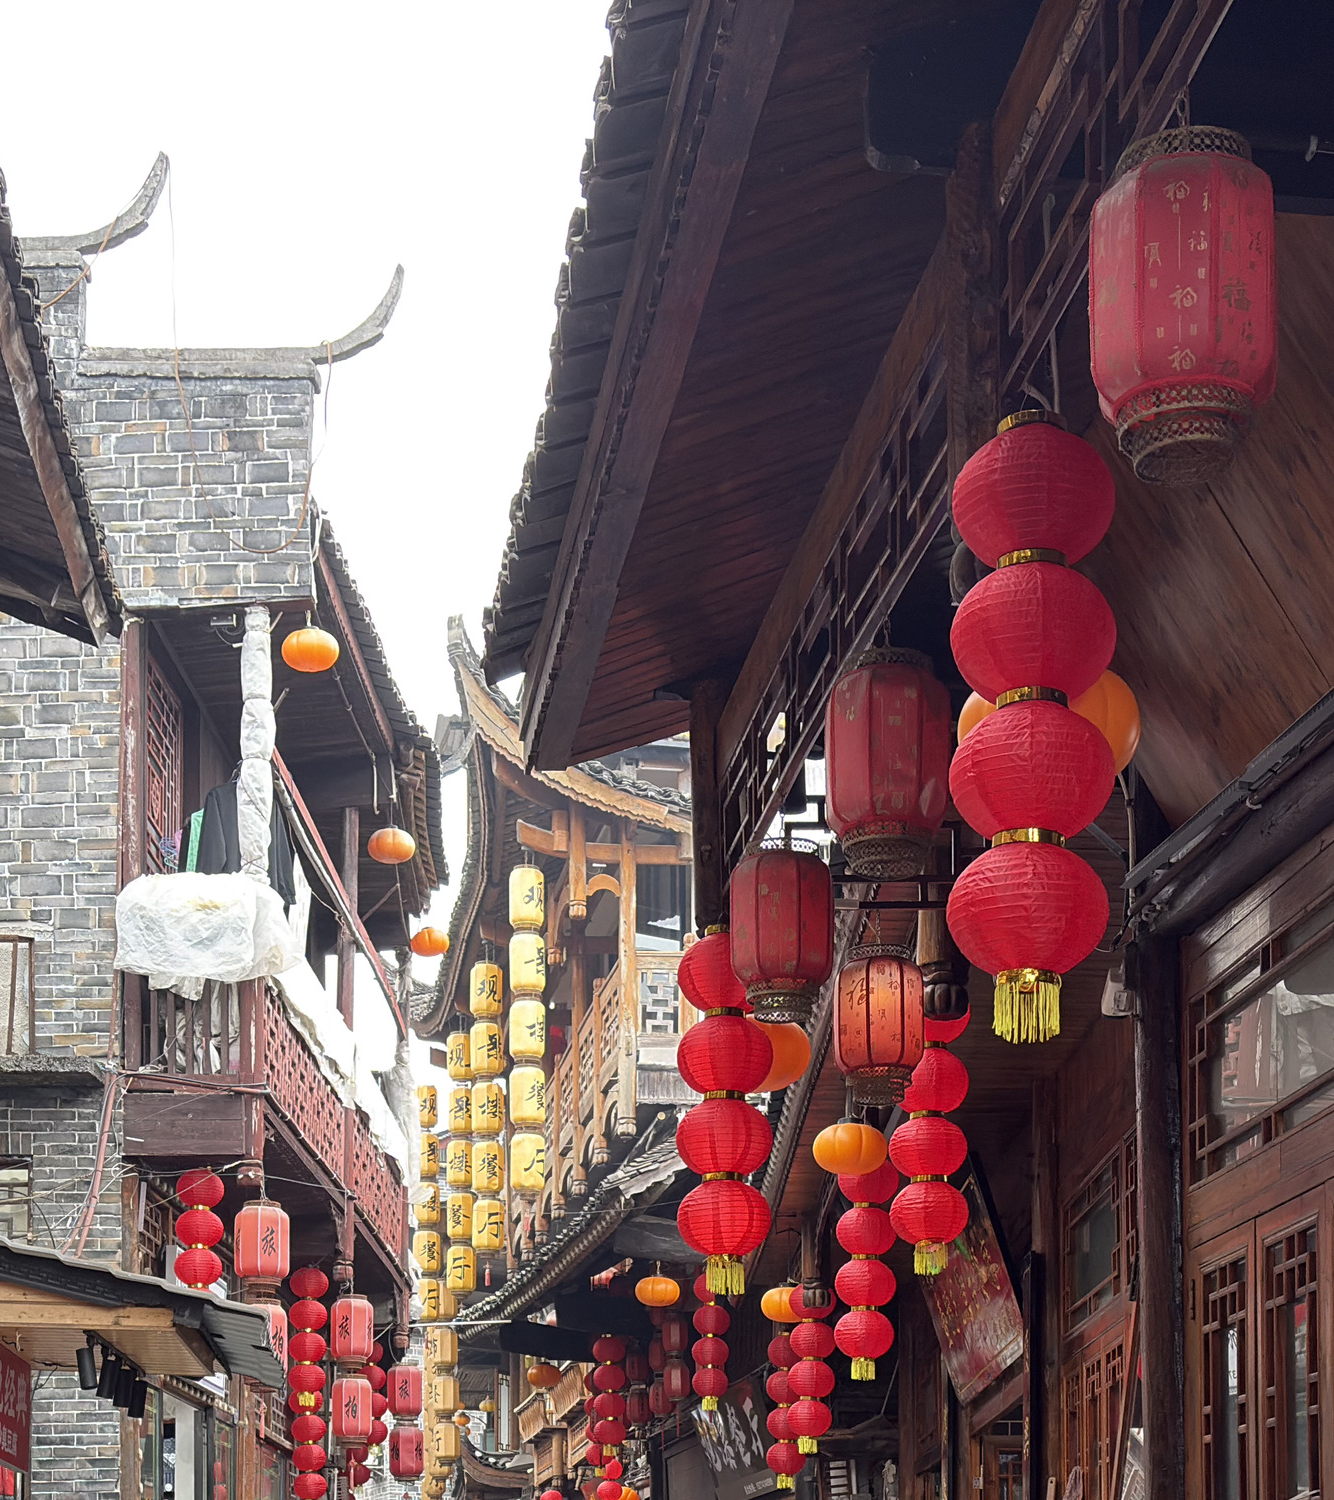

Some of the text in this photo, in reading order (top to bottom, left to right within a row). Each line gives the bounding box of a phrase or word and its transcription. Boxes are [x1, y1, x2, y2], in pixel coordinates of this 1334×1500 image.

[476, 974, 504, 1239] 观景楼餐厅
